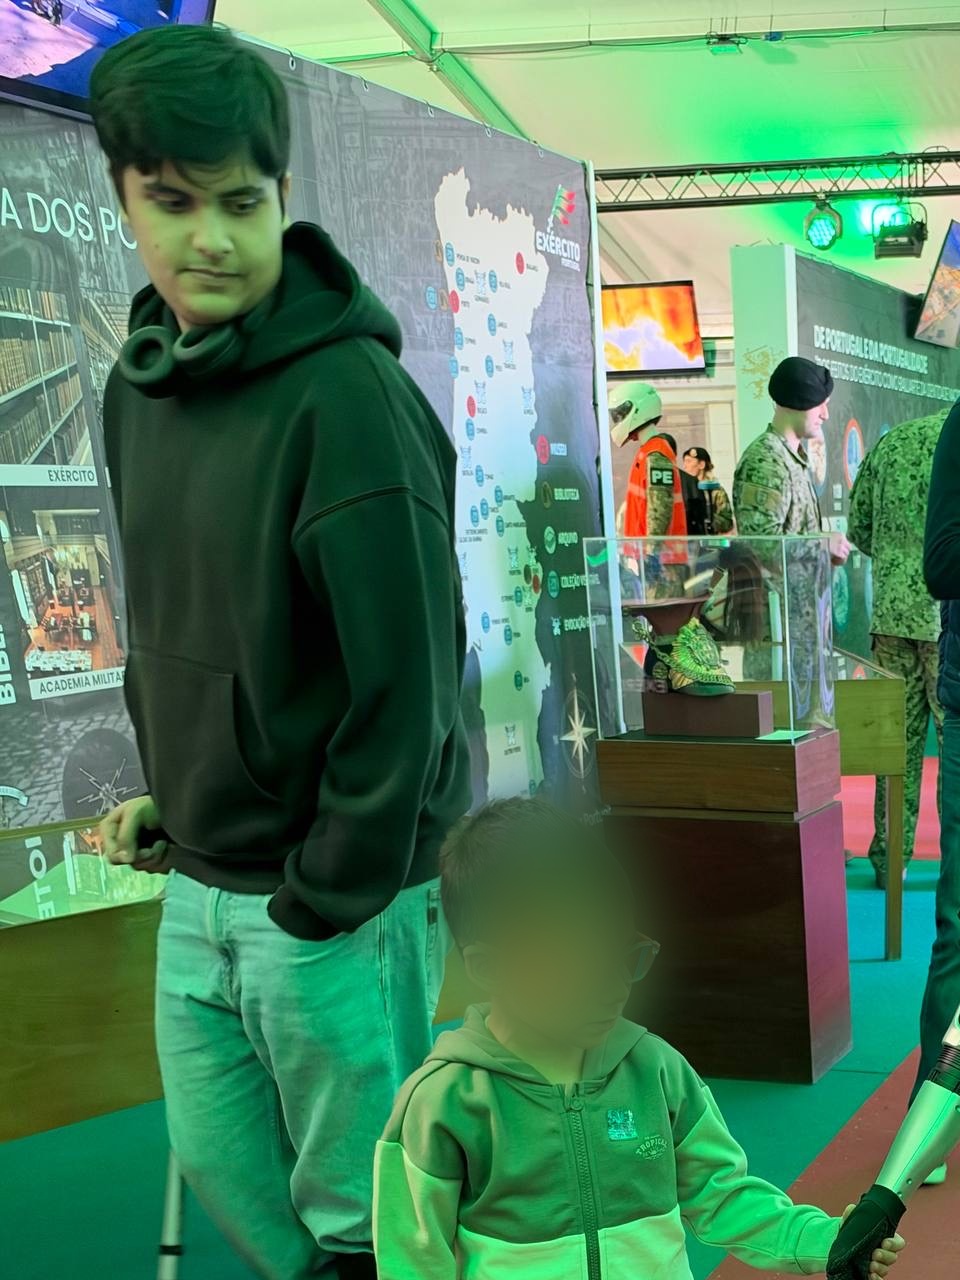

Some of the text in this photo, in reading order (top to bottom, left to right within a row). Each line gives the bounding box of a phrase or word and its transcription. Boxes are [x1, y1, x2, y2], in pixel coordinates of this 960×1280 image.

[27, 191, 94, 241] DOS
[536, 230, 581, 262] EXÉRCITO
[47, 466, 95, 482] EXÉRCITO
[651, 470, 673, 484] PE
[40, 674, 91, 694] ACADEMIA
